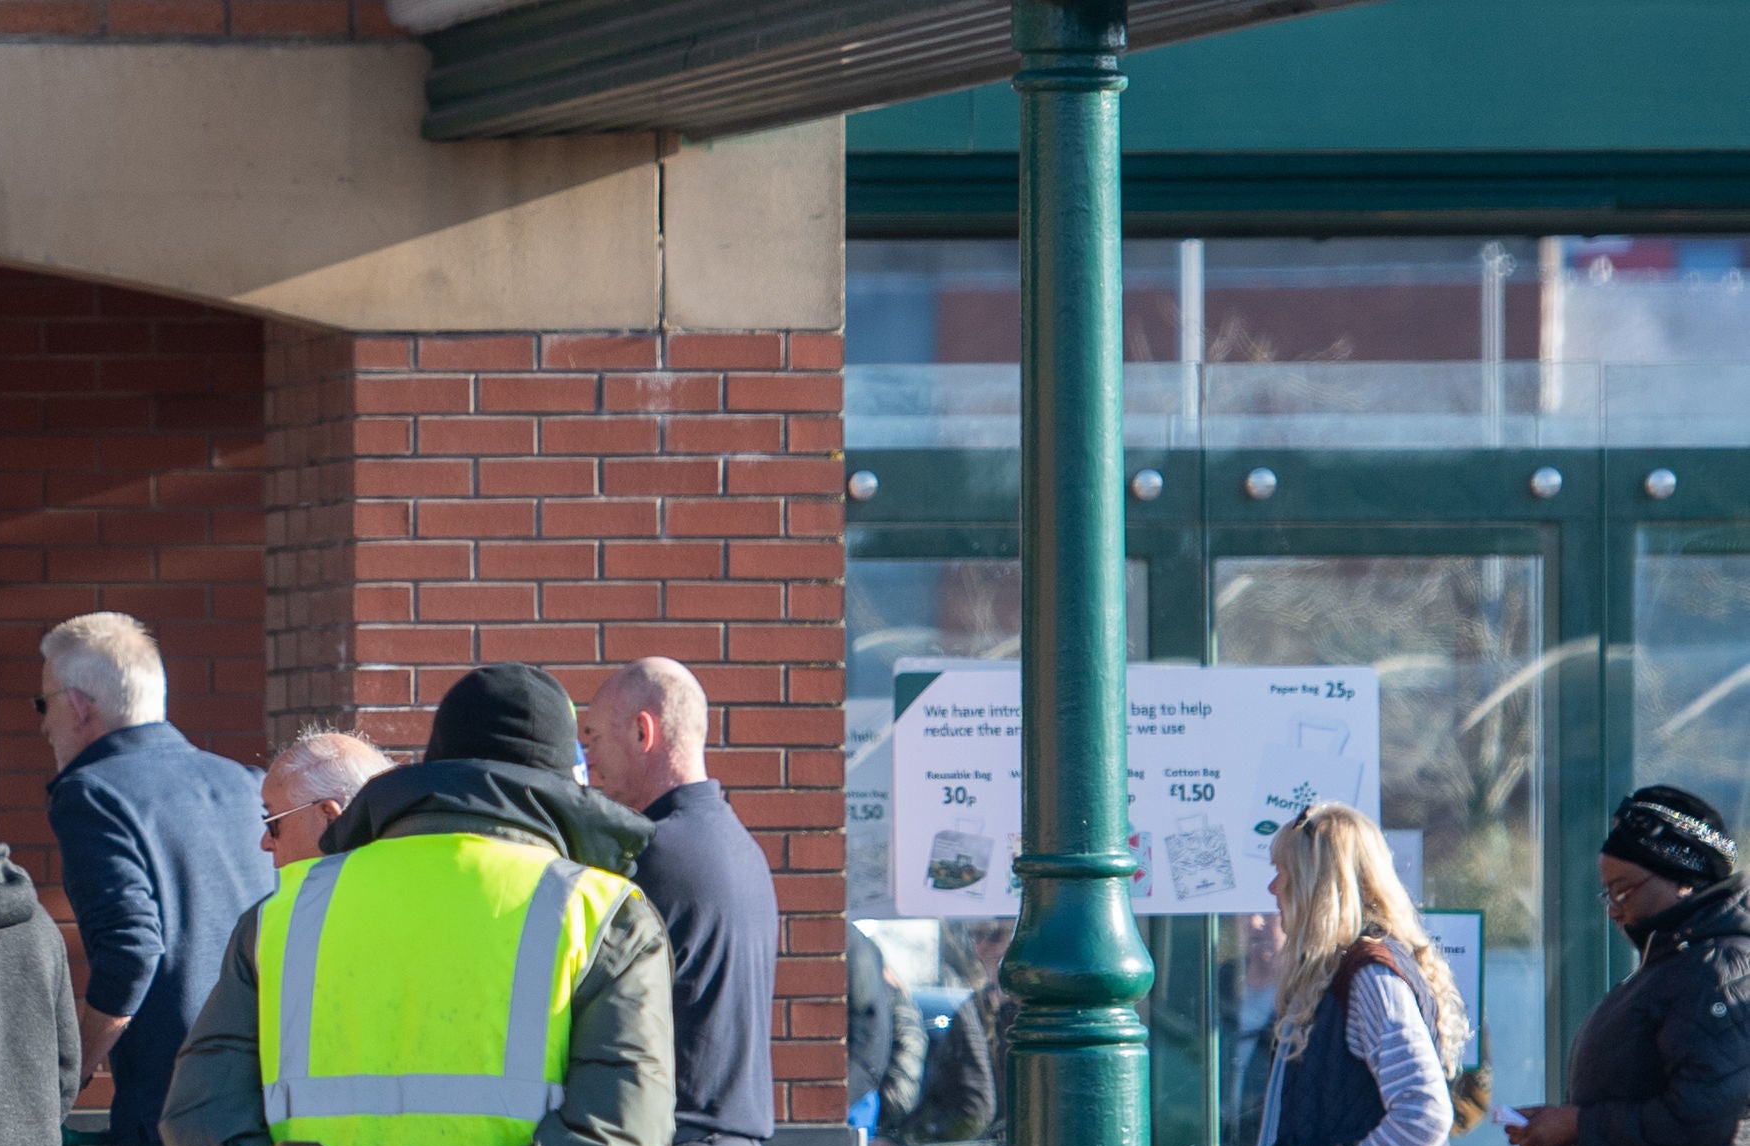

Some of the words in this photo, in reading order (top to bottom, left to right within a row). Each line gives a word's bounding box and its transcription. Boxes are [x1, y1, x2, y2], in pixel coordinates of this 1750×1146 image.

[1270, 685, 1298, 696] Paper
[1301, 685, 1319, 696] Bag
[1326, 680, 1355, 701] 25p
[924, 704, 948, 718] We
[952, 703, 985, 718] have
[1131, 702, 1156, 720] bag
[1160, 704, 1176, 716] to
[1180, 701, 1212, 719] help
[924, 723, 973, 737] reduce
[977, 723, 1001, 736] the
[1137, 725, 1157, 735] we
[1161, 724, 1186, 735] use
[974, 770, 992, 781] Bag
[1127, 769, 1145, 780] Bag
[1164, 768, 1200, 778] Cotton
[1202, 768, 1220, 779] Bag
[943, 786, 977, 807] 30p
[1169, 783, 1215, 802] £1.50
